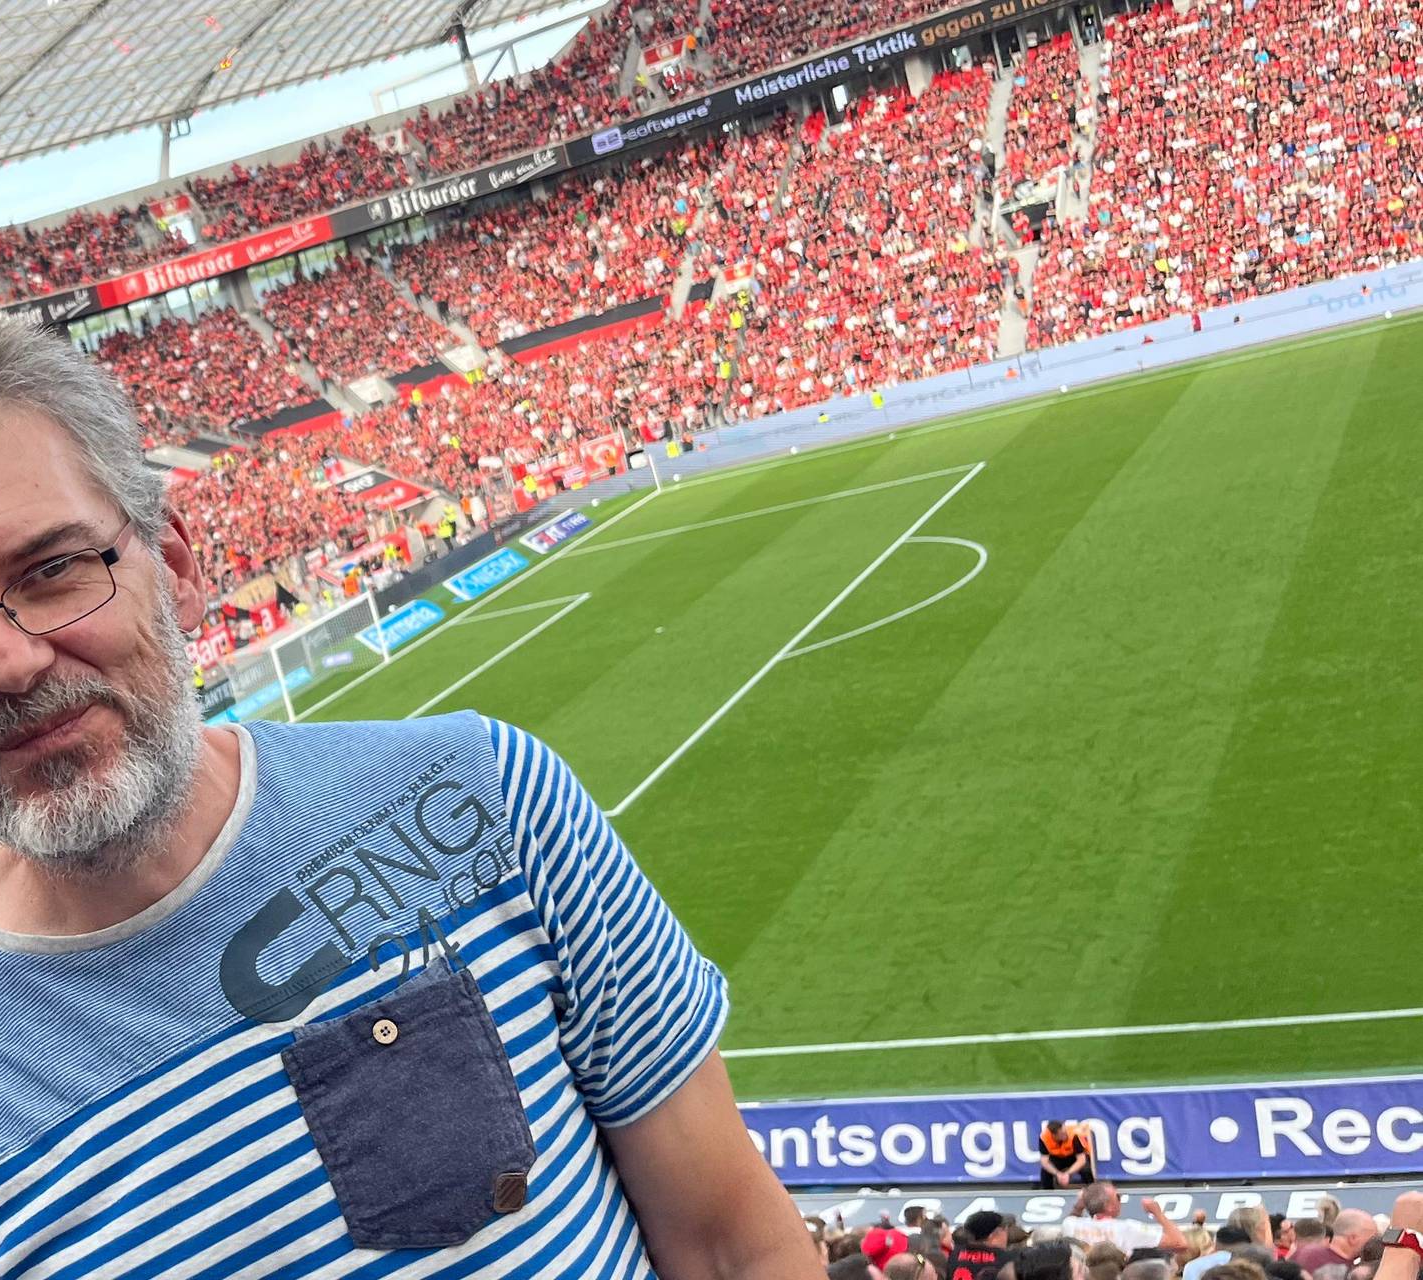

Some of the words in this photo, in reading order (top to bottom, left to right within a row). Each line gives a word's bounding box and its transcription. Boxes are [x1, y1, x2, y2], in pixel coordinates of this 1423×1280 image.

[735, 54, 850, 106] Meisterliche
[852, 31, 918, 65] Taktik
[920, 11, 985, 47] gegen
[991, 1, 1017, 21] zu
[388, 176, 477, 219] Bitburger
[144, 251, 235, 292] Bitburger
[1254, 1097, 1423, 1158] Rec
[897, 1190, 1330, 1225] CASORE
